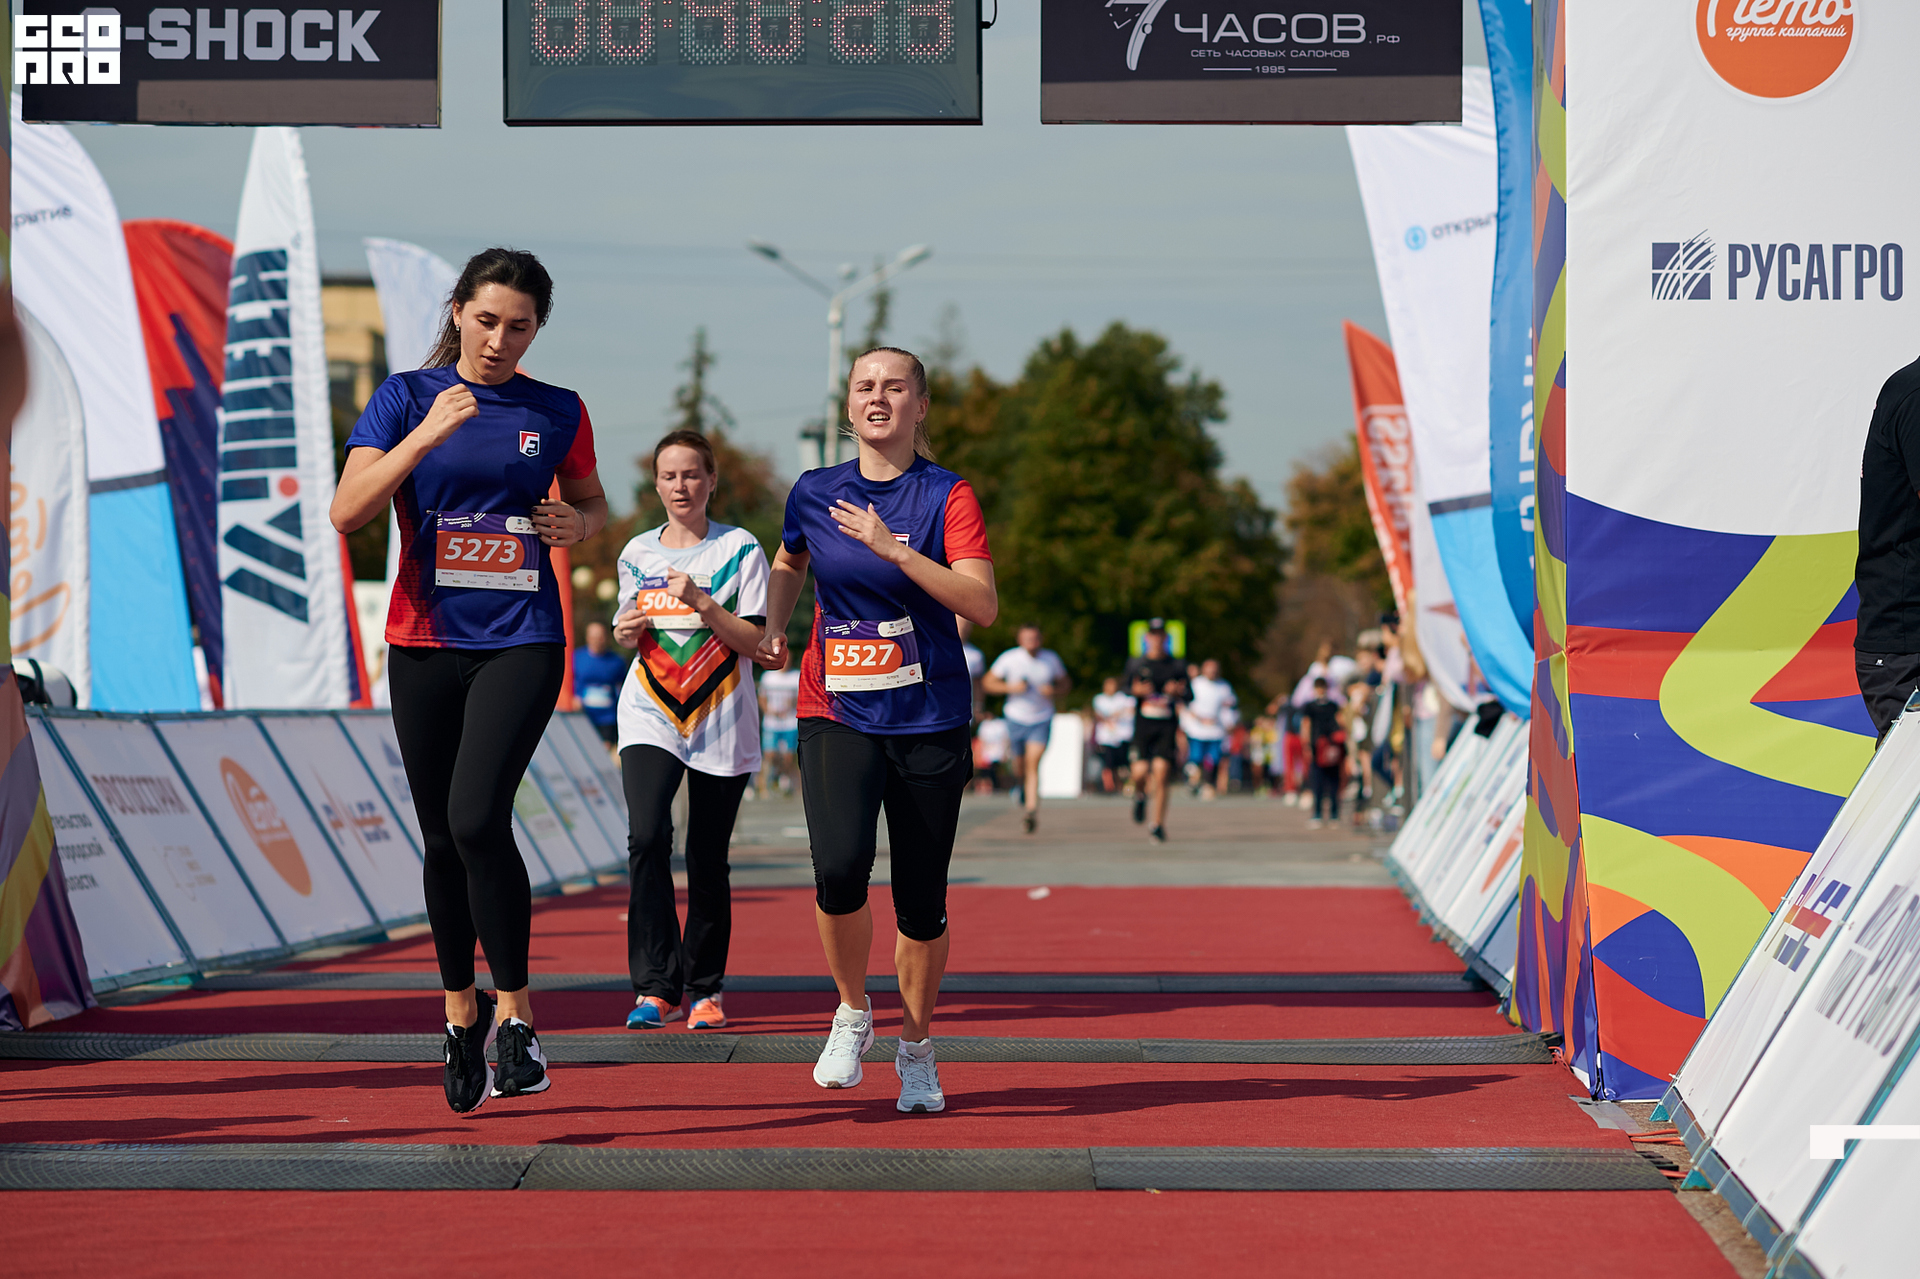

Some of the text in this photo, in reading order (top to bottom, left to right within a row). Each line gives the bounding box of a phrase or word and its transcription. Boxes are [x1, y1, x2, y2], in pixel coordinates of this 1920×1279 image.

[1726, 25, 1847, 42] группа компаний
[1190, 49, 1350, 58] СЕТЬ ЧАСОВЫХ САЛОНОВ
[1254, 65, 1286, 74] 1995
[1727, 242, 1904, 302] РУСАГРО
[444, 537, 517, 564] 5273
[831, 643, 895, 667] 5527
